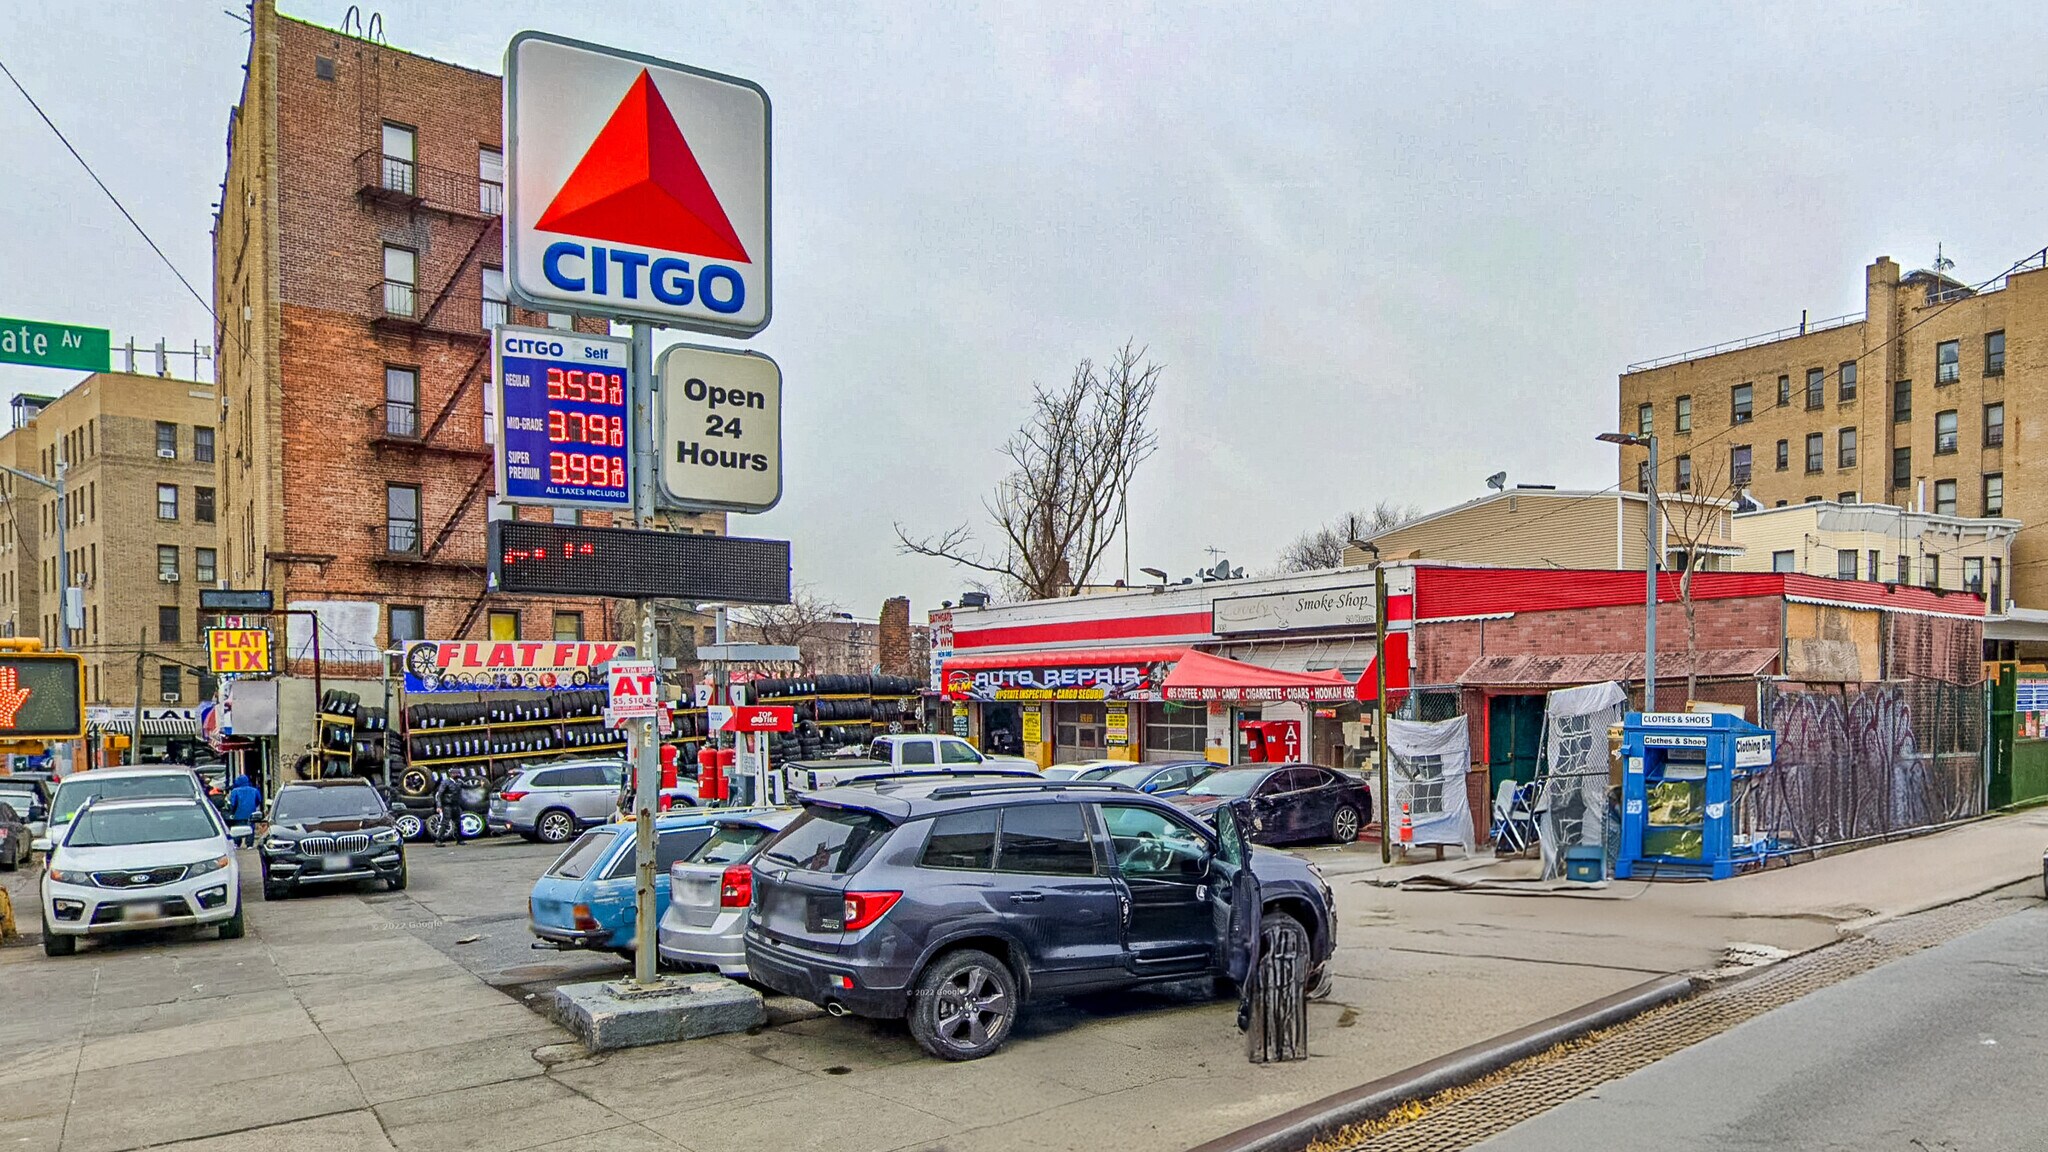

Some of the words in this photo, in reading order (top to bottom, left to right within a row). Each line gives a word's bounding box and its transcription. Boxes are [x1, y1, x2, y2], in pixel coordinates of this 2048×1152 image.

[543, 241, 745, 314] CITGO
[61, 329, 82, 349] Av
[505, 338, 564, 357] CITGO
[584, 346, 609, 360] Self
[505, 373, 531, 388] REGULAR
[684, 378, 765, 410] Open
[506, 416, 544, 432] MID-GRADE
[705, 415, 743, 439] 24
[508, 450, 530, 465] SUPER
[676, 441, 768, 472] Hours
[508, 466, 540, 481] PREMIUM
[545, 486, 560, 495] ALL
[561, 487, 586, 496] TAXES
[586, 490, 626, 499] INCLUDED
[1295, 595, 1334, 613] Smoke
[1335, 591, 1368, 611] Shop
[642, 602, 652, 658] CASH
[213, 631, 263, 649] FLAT
[215, 650, 264, 670] FIX
[435, 643, 544, 667] FLAT
[552, 643, 618, 668] FIX
[975, 669, 1034, 687] AUTO
[1044, 665, 1141, 687] REPAIR
[700, 690, 706, 700] 2
[736, 690, 741, 700] 1
[1019, 689, 1053, 700] INSPECTION
[1057, 689, 1077, 700] CARGO
[1166, 687, 1177, 699] 495
[1177, 687, 1198, 699] COFFEE
[1202, 688, 1217, 699] SODA
[1221, 688, 1241, 699] CANDY
[1245, 688, 1282, 699] CIGARRETTE
[1286, 688, 1310, 699] CIGARS
[1314, 687, 1342, 699] HOOKAH
[1343, 686, 1355, 699] 495
[1643, 715, 1676, 724] CLOTHES
[1677, 716, 1683, 724] &
[1685, 715, 1711, 724] SHOES
[1285, 725, 1299, 763] ATM
[1644, 737, 1673, 746] Clothes
[1675, 737, 1681, 745] &
[1683, 737, 1707, 746] Shoes
[1736, 739, 1760, 754] Clothing
